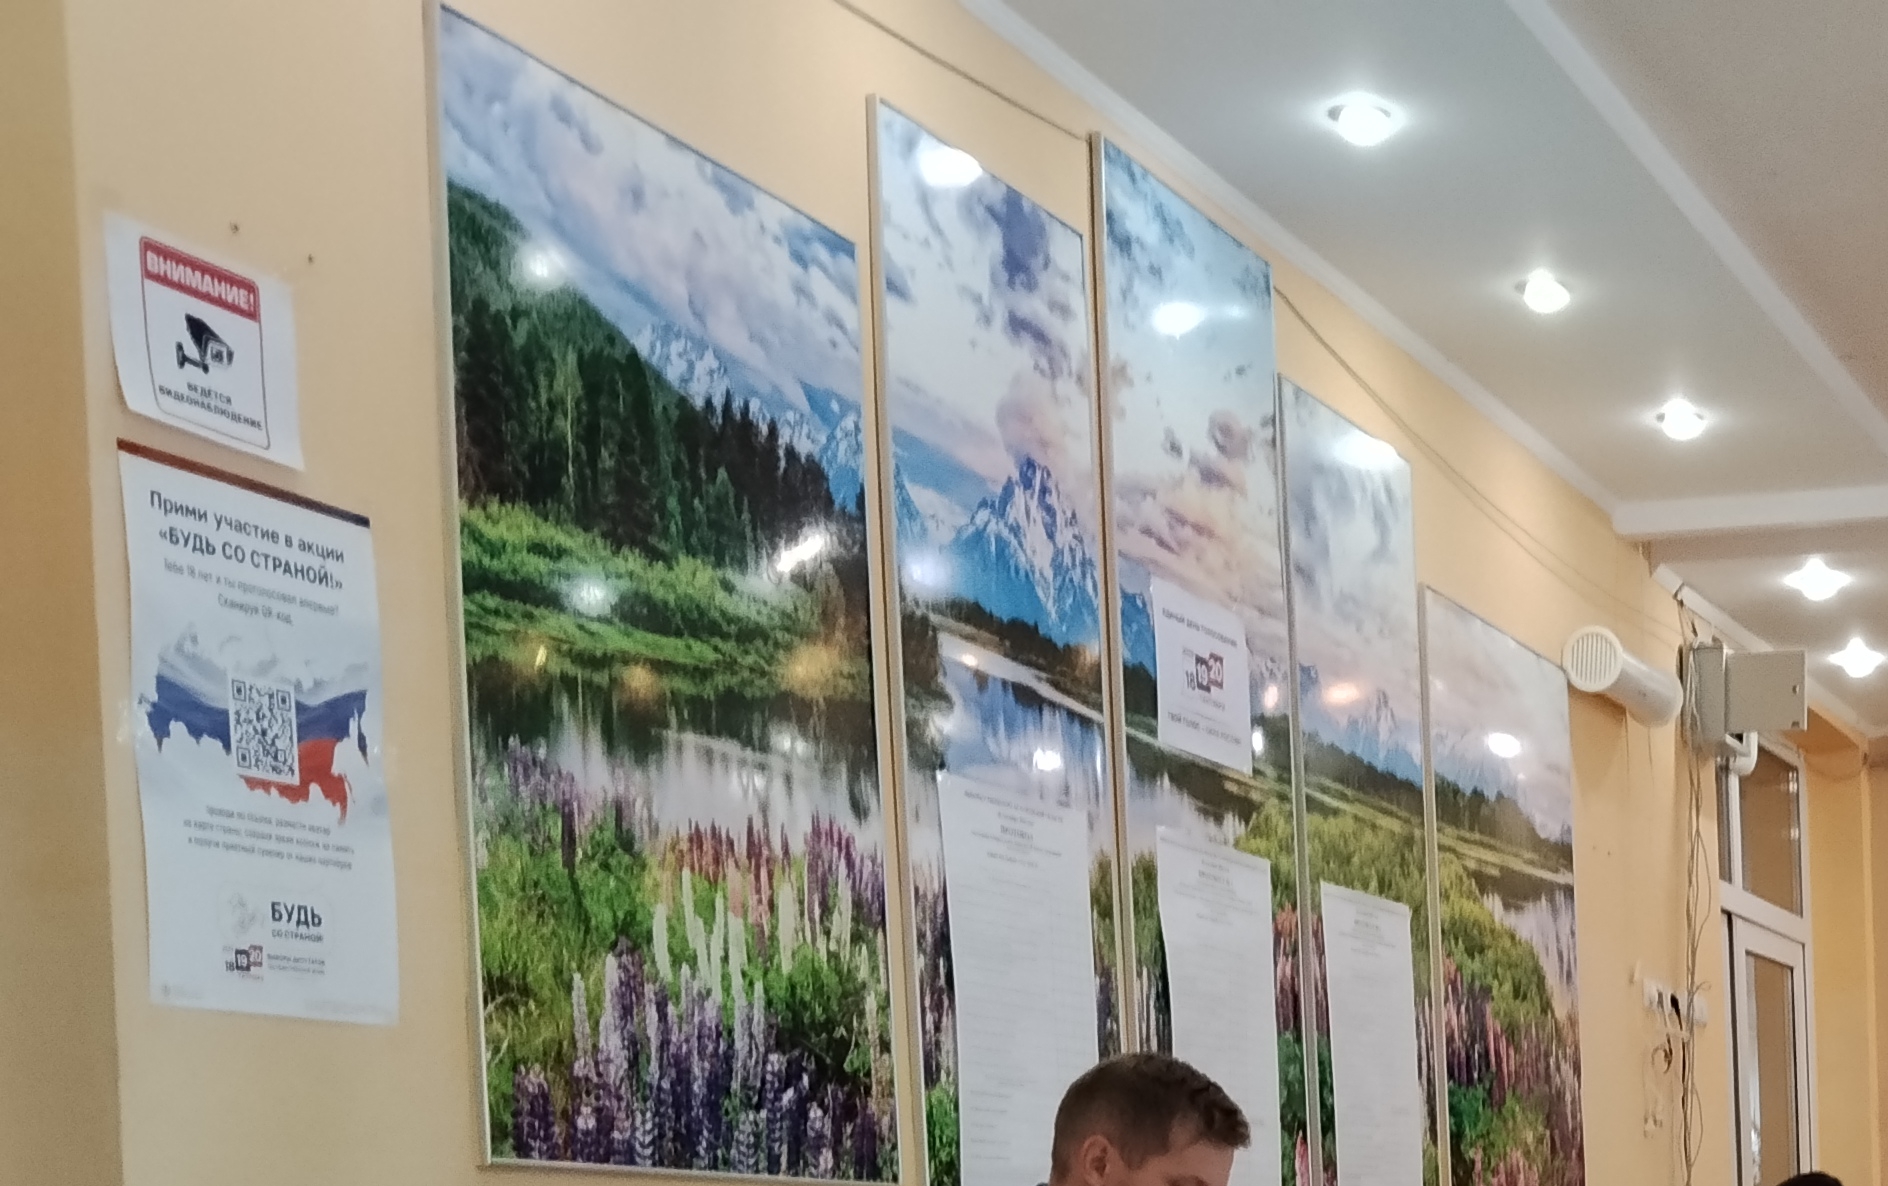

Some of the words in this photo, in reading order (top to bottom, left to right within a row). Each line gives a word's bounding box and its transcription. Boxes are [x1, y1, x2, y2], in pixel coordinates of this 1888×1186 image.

[146, 250, 254, 312] ВНИМАНИЕ!
[158, 384, 263, 431] ВИДЕОНАБЛЮДЕНИЕ
[150, 490, 208, 522] Прими
[213, 512, 280, 544] участие
[285, 535, 293, 548] в
[297, 538, 345, 563] акции
[158, 526, 216, 557] «БУДЬ
[221, 541, 245, 563] СО
[250, 549, 343, 590] СТРАНОЙ!»
[164, 558, 184, 575] Тебе
[187, 564, 196, 579] 18
[1208, 657, 1223, 684] 20
[271, 901, 323, 930] БУДЬ
[225, 960, 236, 972] 18
[236, 953, 248, 968] 19
[249, 949, 261, 963] 20
